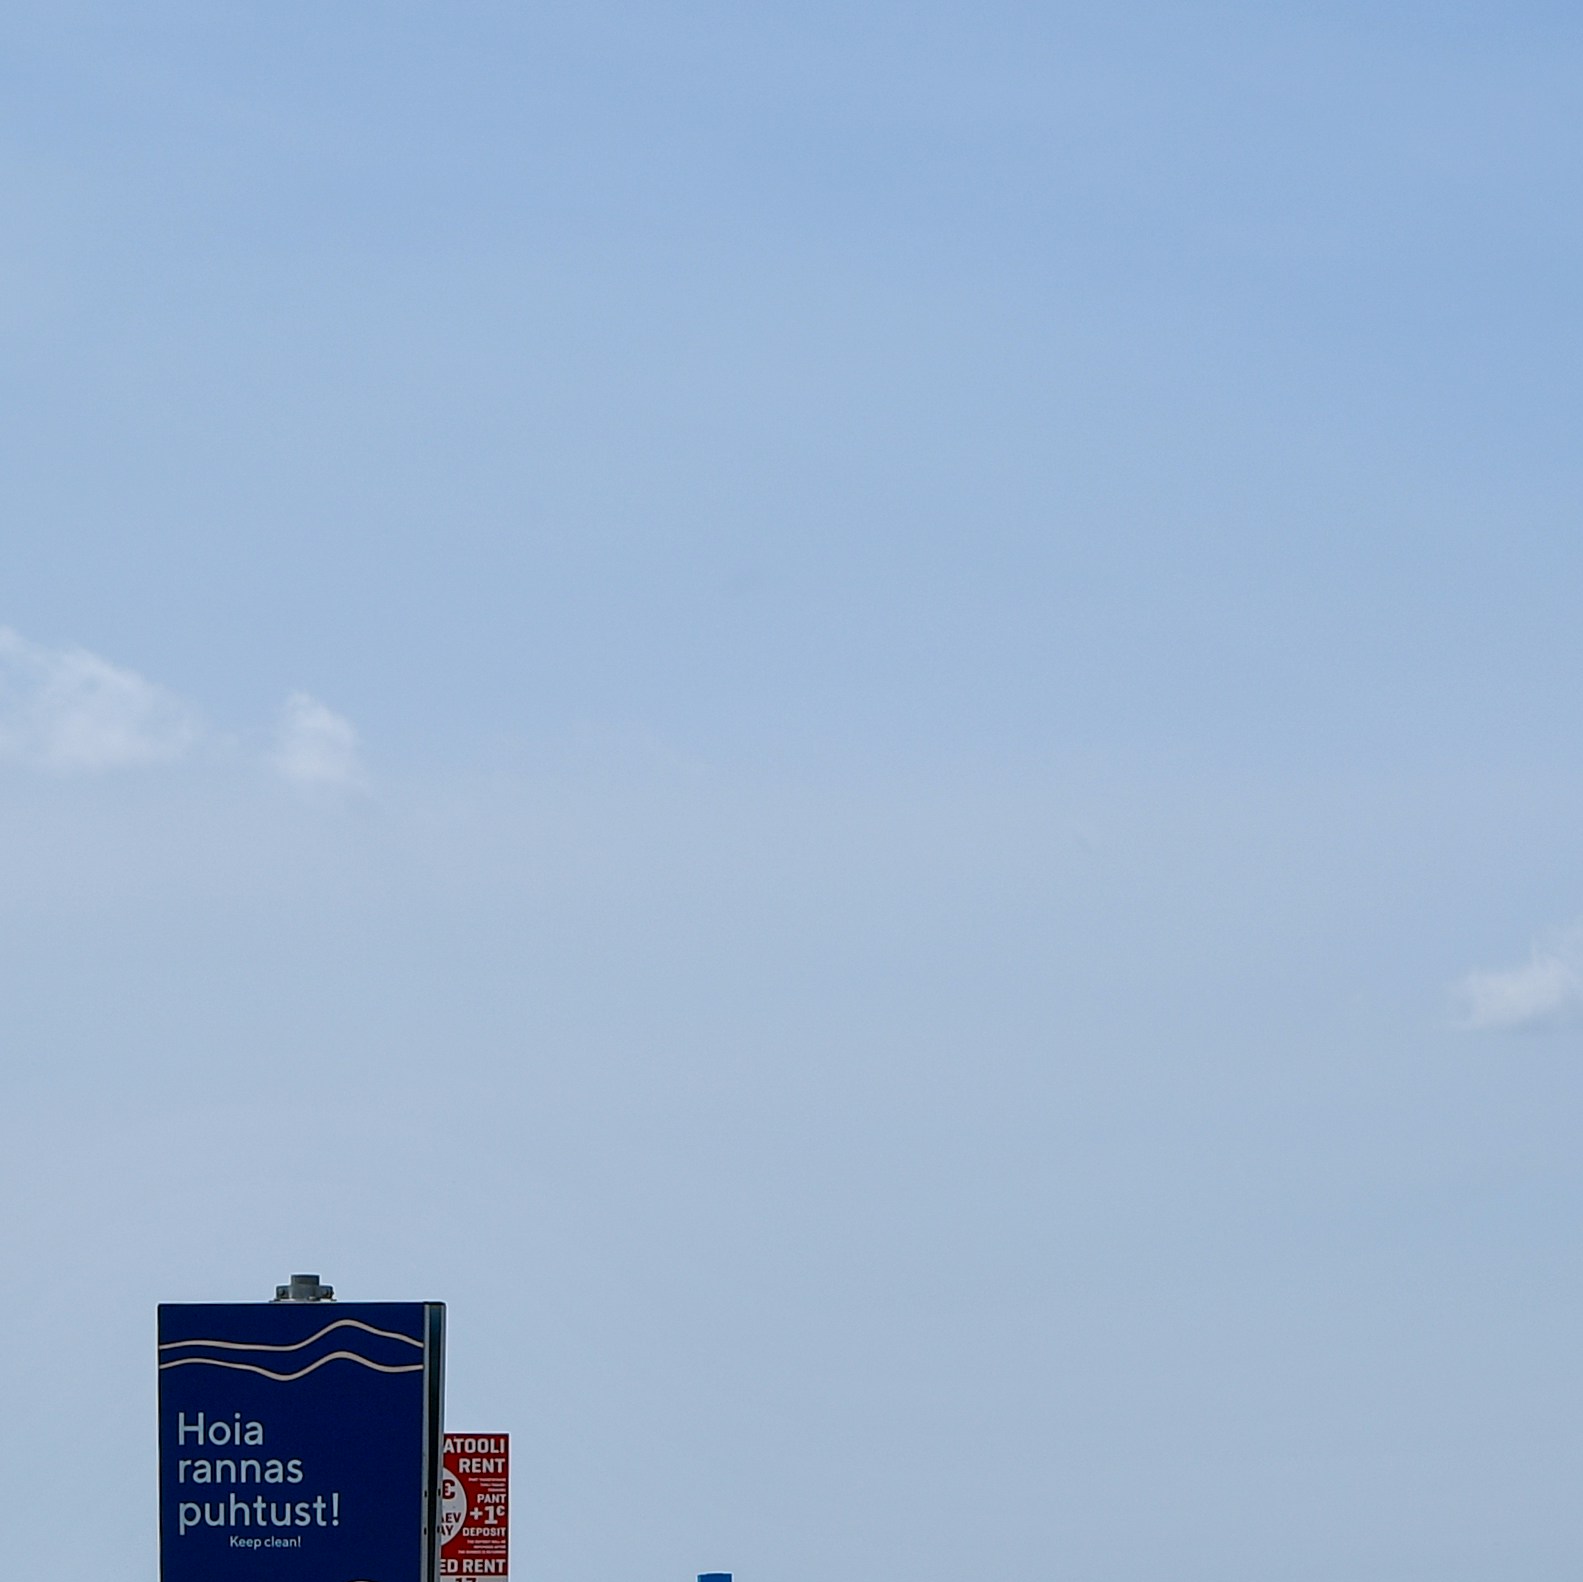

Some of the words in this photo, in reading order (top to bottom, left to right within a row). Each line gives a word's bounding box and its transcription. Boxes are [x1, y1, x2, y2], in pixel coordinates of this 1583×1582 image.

[178, 1412, 264, 1446] Hoia
[178, 1457, 303, 1484] rannas
[459, 1457, 506, 1473] RENT
[477, 1493, 506, 1504] PANT
[178, 1492, 340, 1535] puhtust!
[462, 1527, 506, 1537] DEPOSIT
[229, 1535, 262, 1550] Keep
[264, 1535, 302, 1549] clean!
[462, 1559, 506, 1574] RENT
